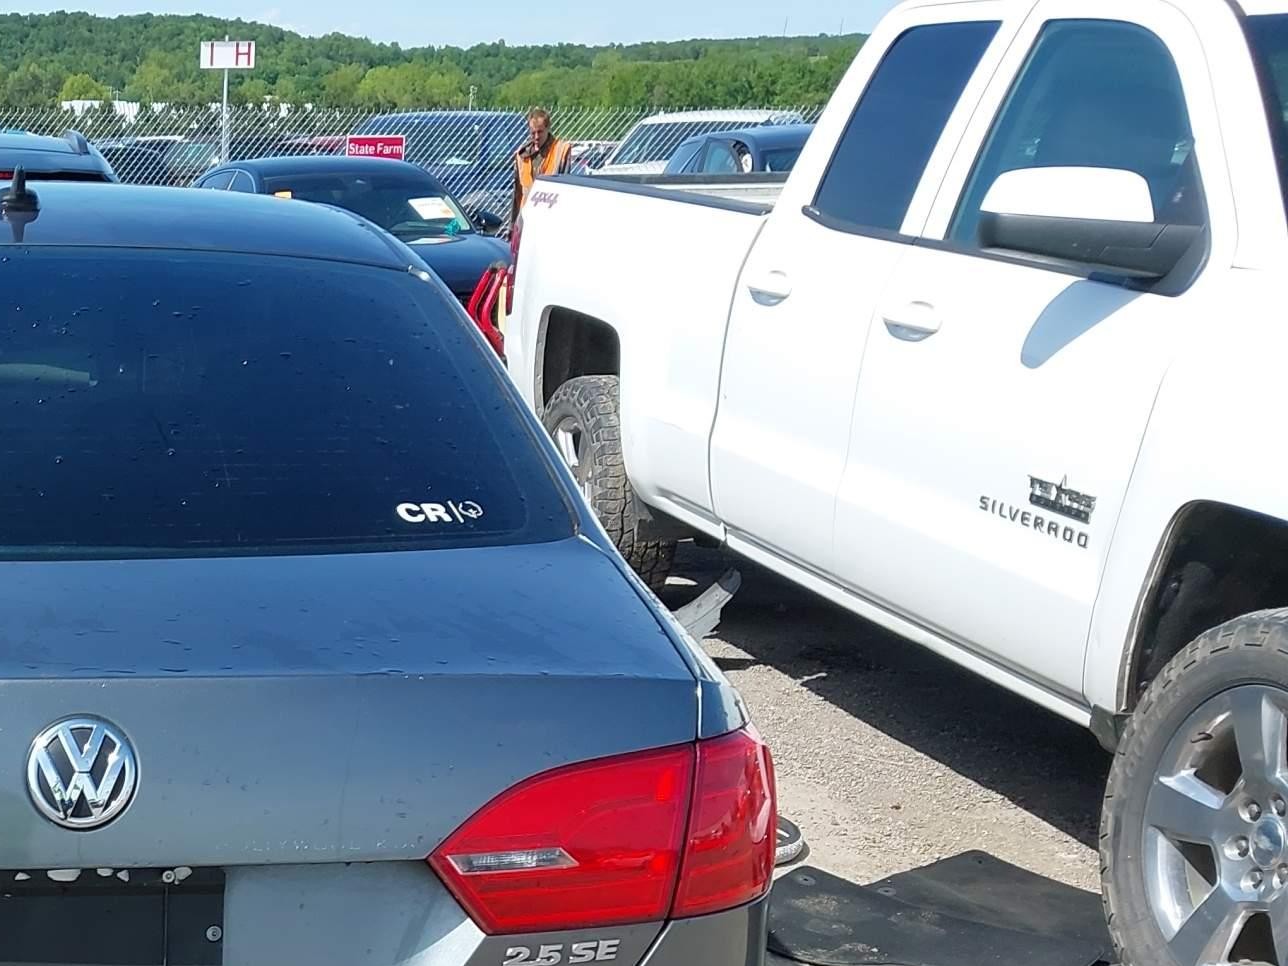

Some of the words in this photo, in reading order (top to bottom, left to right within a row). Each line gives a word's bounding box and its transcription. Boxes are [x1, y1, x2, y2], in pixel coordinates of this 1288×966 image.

[236, 42, 252, 66] H
[348, 142, 375, 155] State
[376, 142, 403, 155] Farm
[979, 495, 1089, 549] SILVERADO
[568, 939, 621, 965] SE
